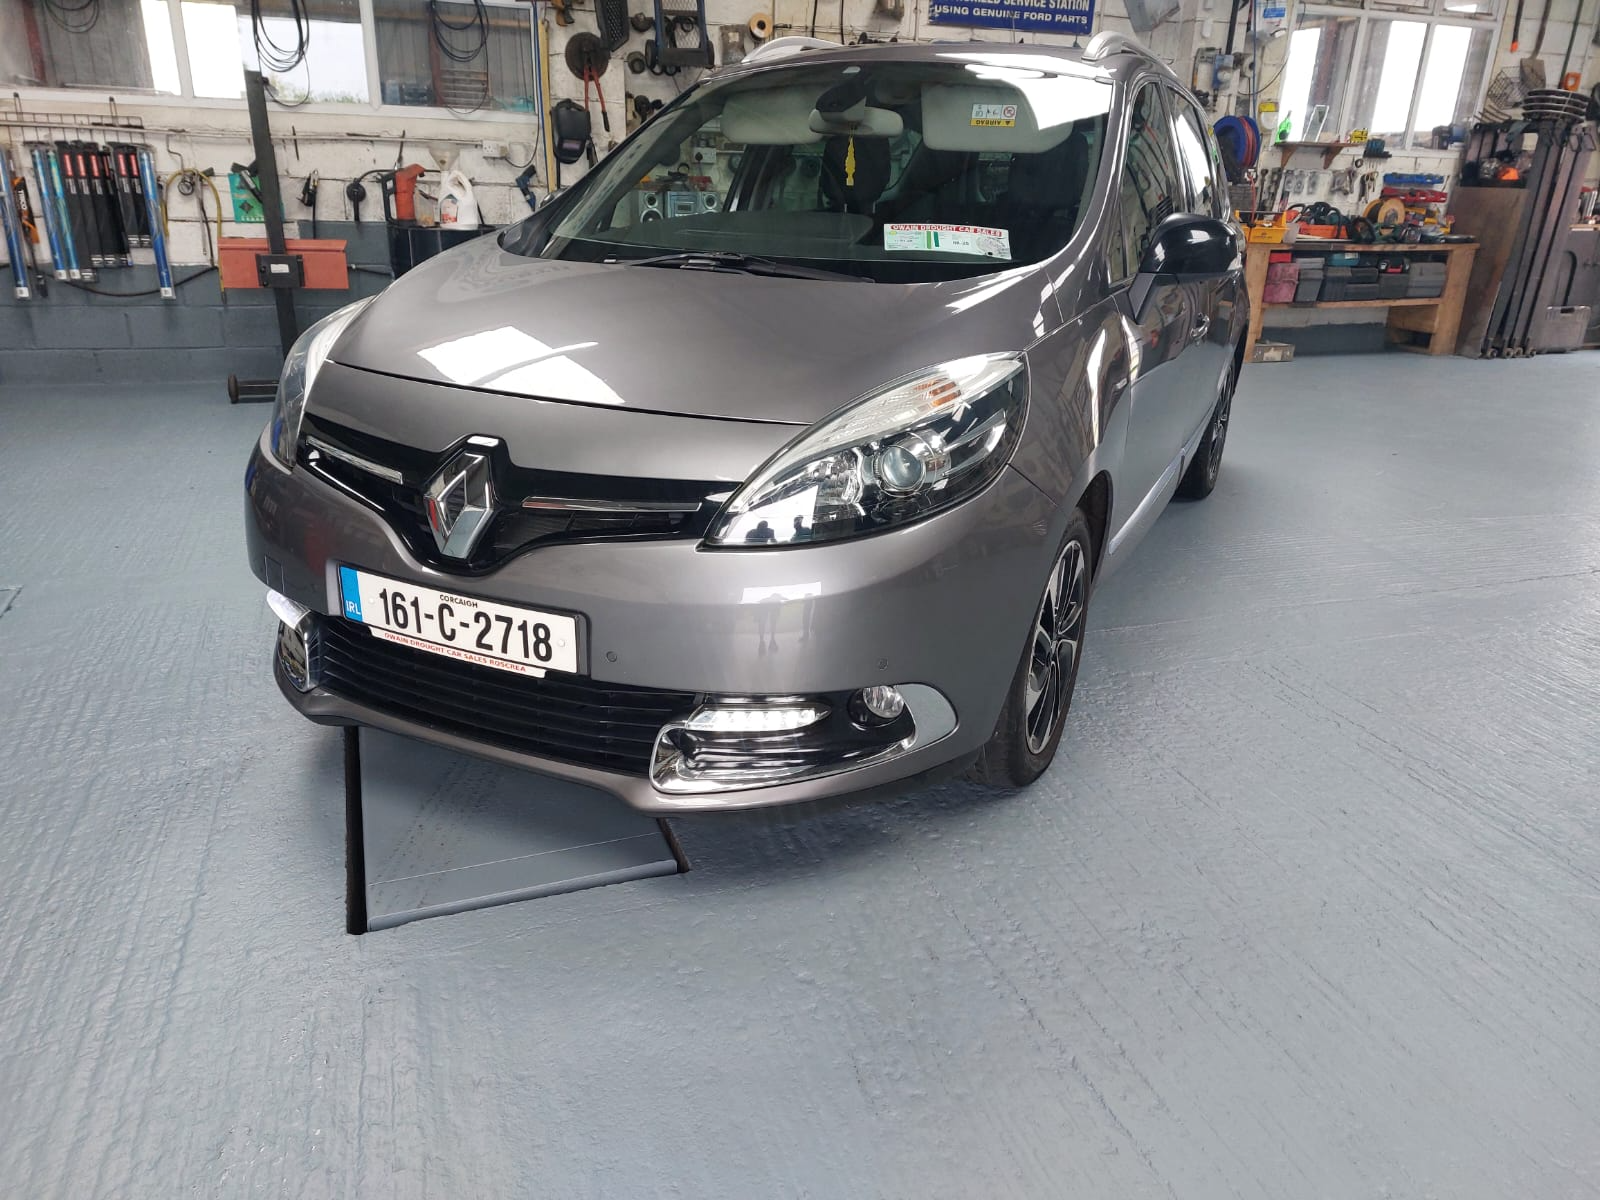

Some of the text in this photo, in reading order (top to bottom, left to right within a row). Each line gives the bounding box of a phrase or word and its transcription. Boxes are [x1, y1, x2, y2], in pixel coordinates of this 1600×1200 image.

[934, 4, 1088, 24] USING GENUINE FORD PARTS
[1048, 0, 1089, 11] STATION
[346, 600, 361, 615] IRL
[439, 594, 478, 608] CORCAIGH
[379, 588, 552, 663] 161-C-2718
[384, 632, 526, 672] OWAIN DROUGHT CAR SALES ROSCREA
